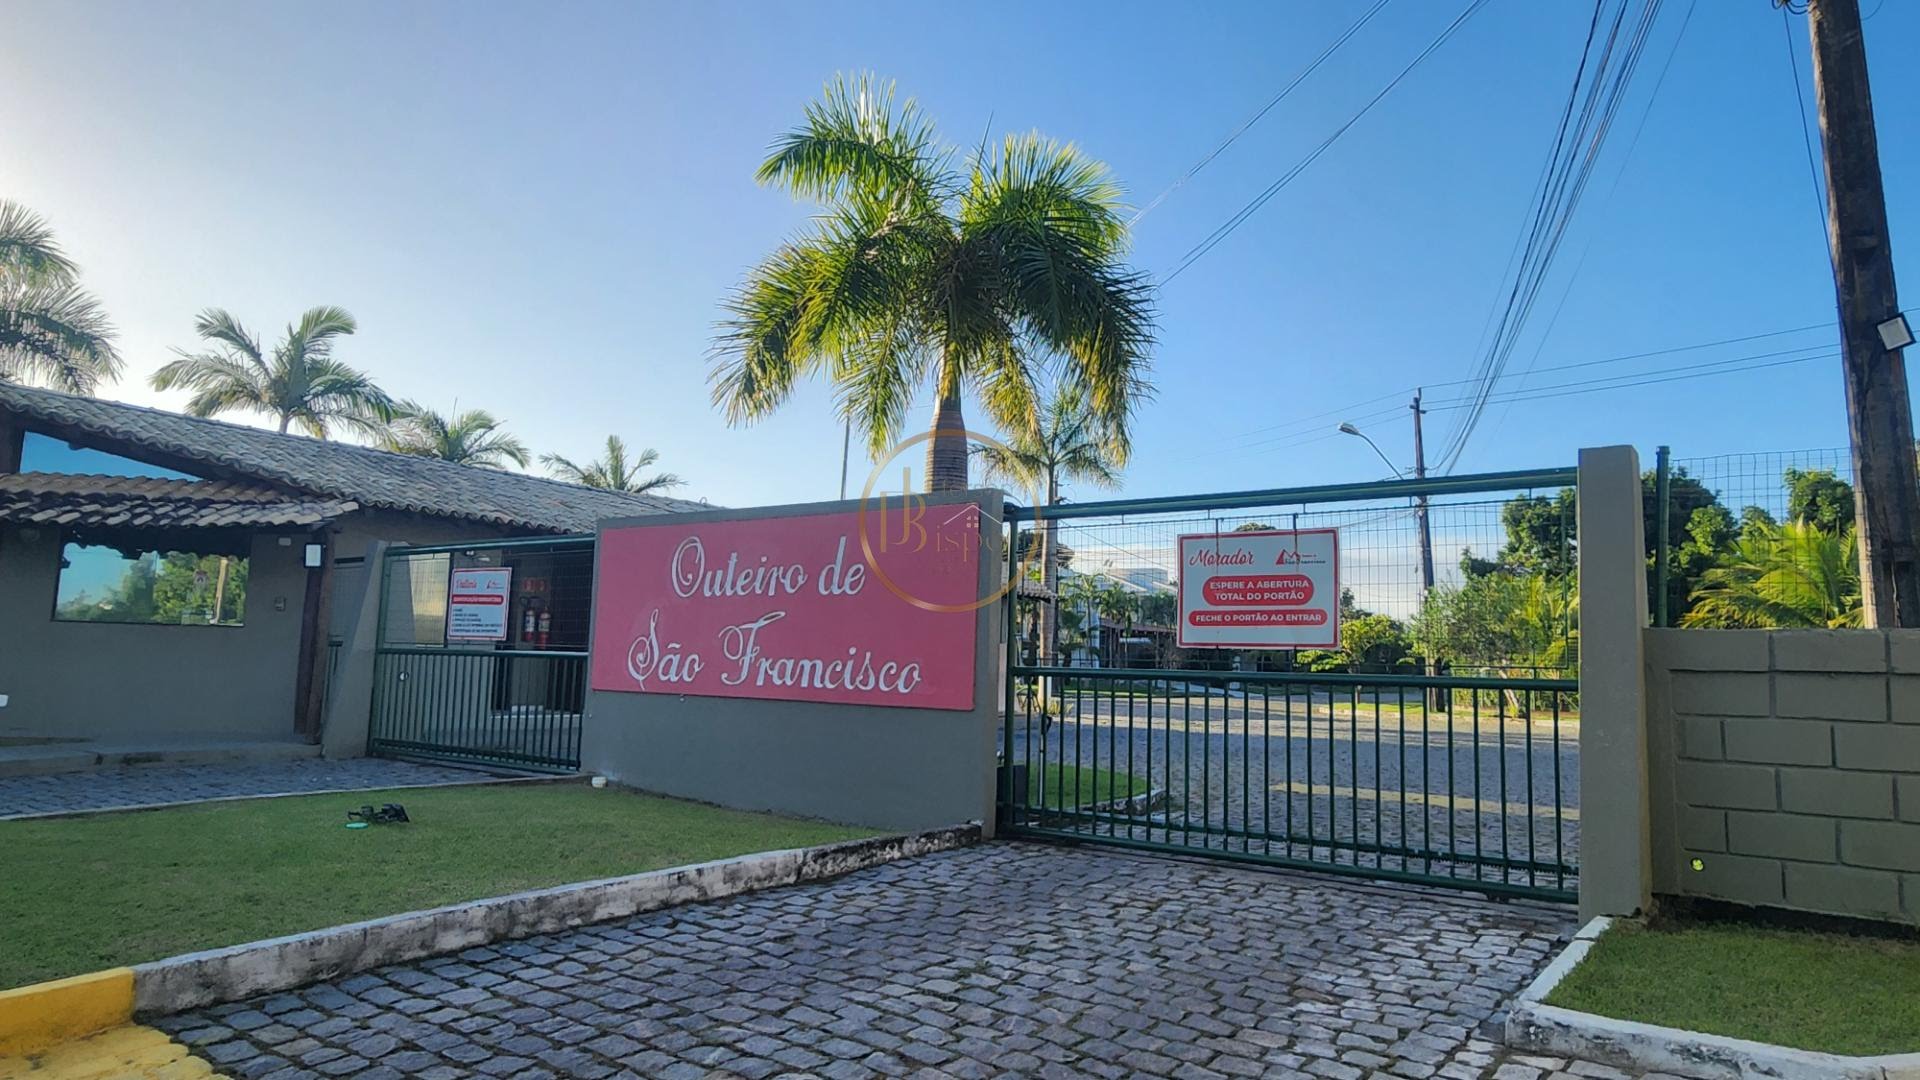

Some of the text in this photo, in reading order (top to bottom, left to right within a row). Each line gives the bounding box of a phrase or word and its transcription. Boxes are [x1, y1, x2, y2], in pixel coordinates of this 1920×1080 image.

[1189, 548, 1254, 567] Morador
[671, 535, 865, 598] Outeiro de
[1209, 580, 1309, 590] ESPERE A ABERTURA
[1215, 590, 1305, 601] TOTAL DO PORTÃO
[1196, 612, 1322, 622] FECHE O PORTÃO AO ENTRAR
[627, 608, 922, 694] São Francisco
